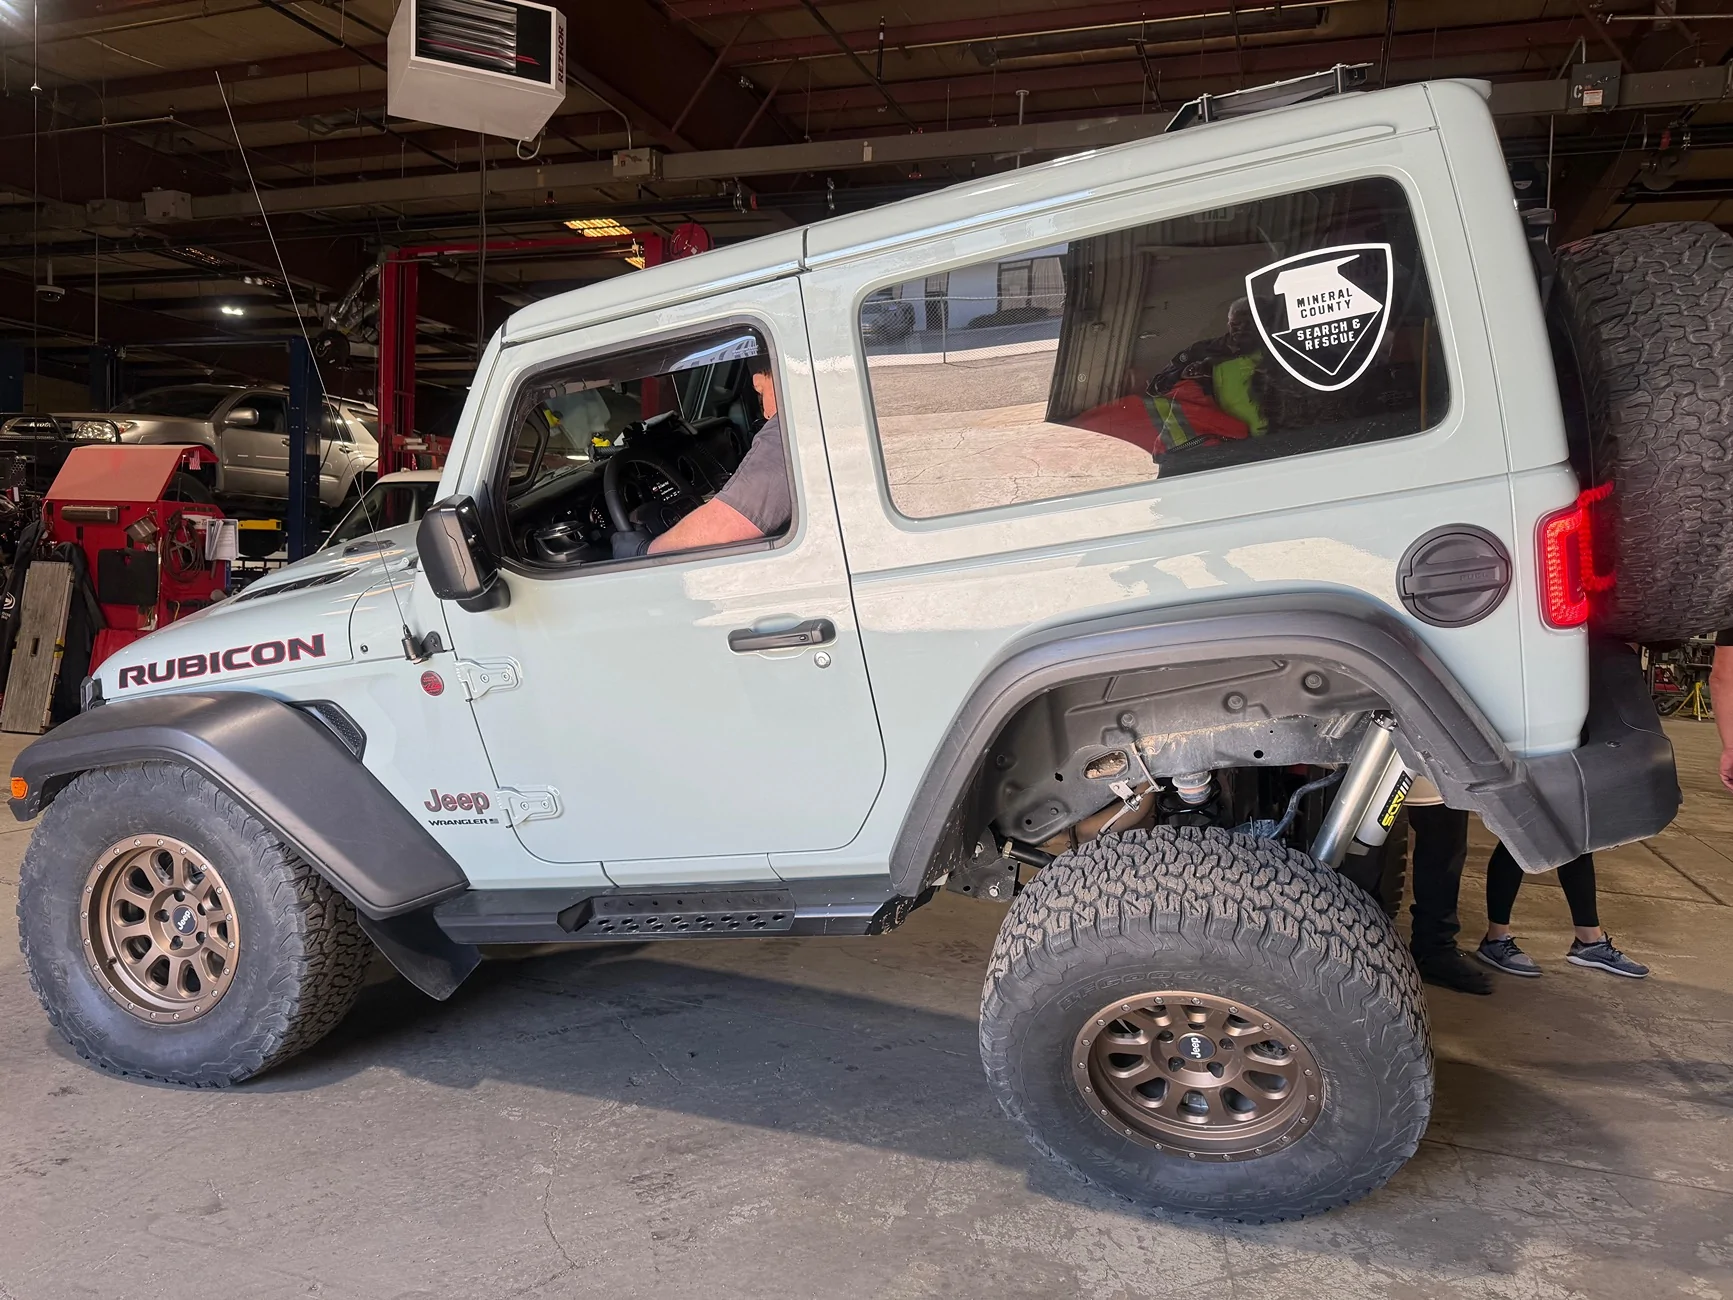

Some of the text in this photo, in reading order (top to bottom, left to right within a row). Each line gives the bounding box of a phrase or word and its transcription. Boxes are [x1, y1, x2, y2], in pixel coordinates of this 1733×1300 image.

[1296, 287, 1353, 308] MINERAL
[1300, 299, 1351, 319] COUNTY
[1296, 318, 1361, 341] SEARCH &
[1305, 331, 1355, 351] RESCUE
[118, 633, 326, 690] RUBICON
[423, 788, 490, 815] Jeep
[1381, 789, 1405, 827] ADS
[428, 818, 489, 827] WRANGLER
[177, 909, 191, 931] Jeep
[1190, 1037, 1202, 1059] Jeep
